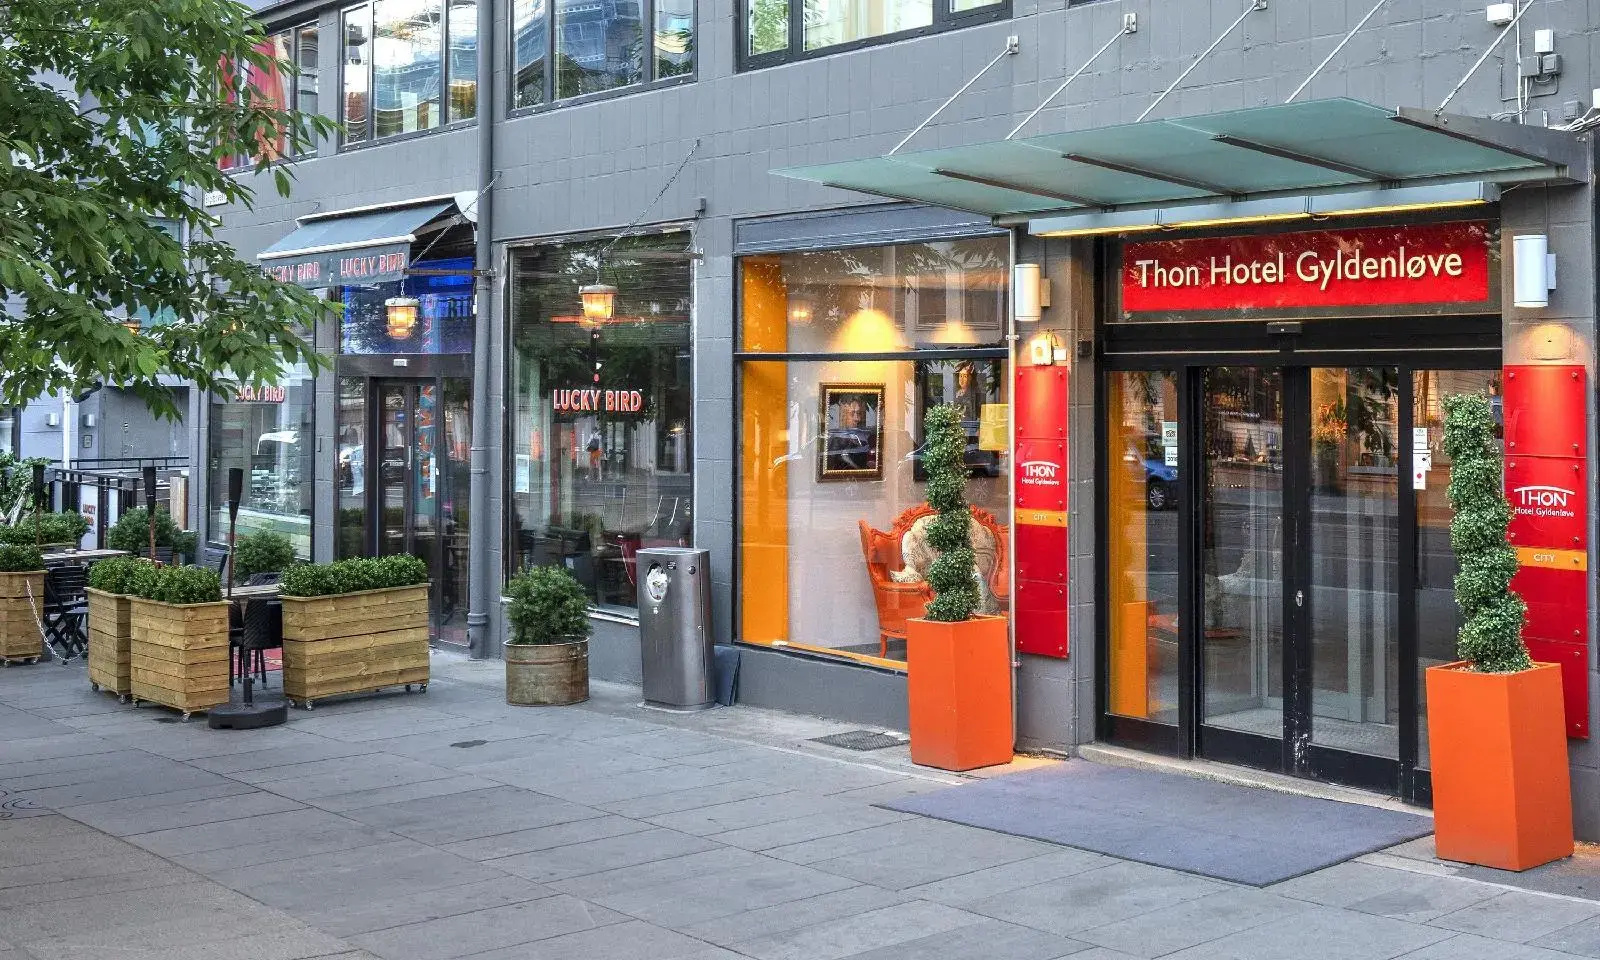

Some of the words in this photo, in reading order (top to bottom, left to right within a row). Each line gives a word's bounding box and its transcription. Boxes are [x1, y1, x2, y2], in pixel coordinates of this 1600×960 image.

[297, 261, 320, 281] BIRD
[340, 256, 376, 276] LUCKY
[379, 252, 405, 273] BIRD
[1135, 259, 1199, 288] Thon
[1211, 252, 1284, 286] Hotel
[1296, 246, 1463, 291] Gyldenløve
[264, 384, 285, 403] BIRD
[553, 389, 601, 411] LUCKY
[605, 390, 642, 412] BIRD
[1021, 460, 1060, 478] THON
[1513, 486, 1575, 507] THON
[1514, 506, 1534, 515] Hotel
[1535, 507, 1575, 518] Gyldenløve
[1533, 553, 1555, 563] CITY
